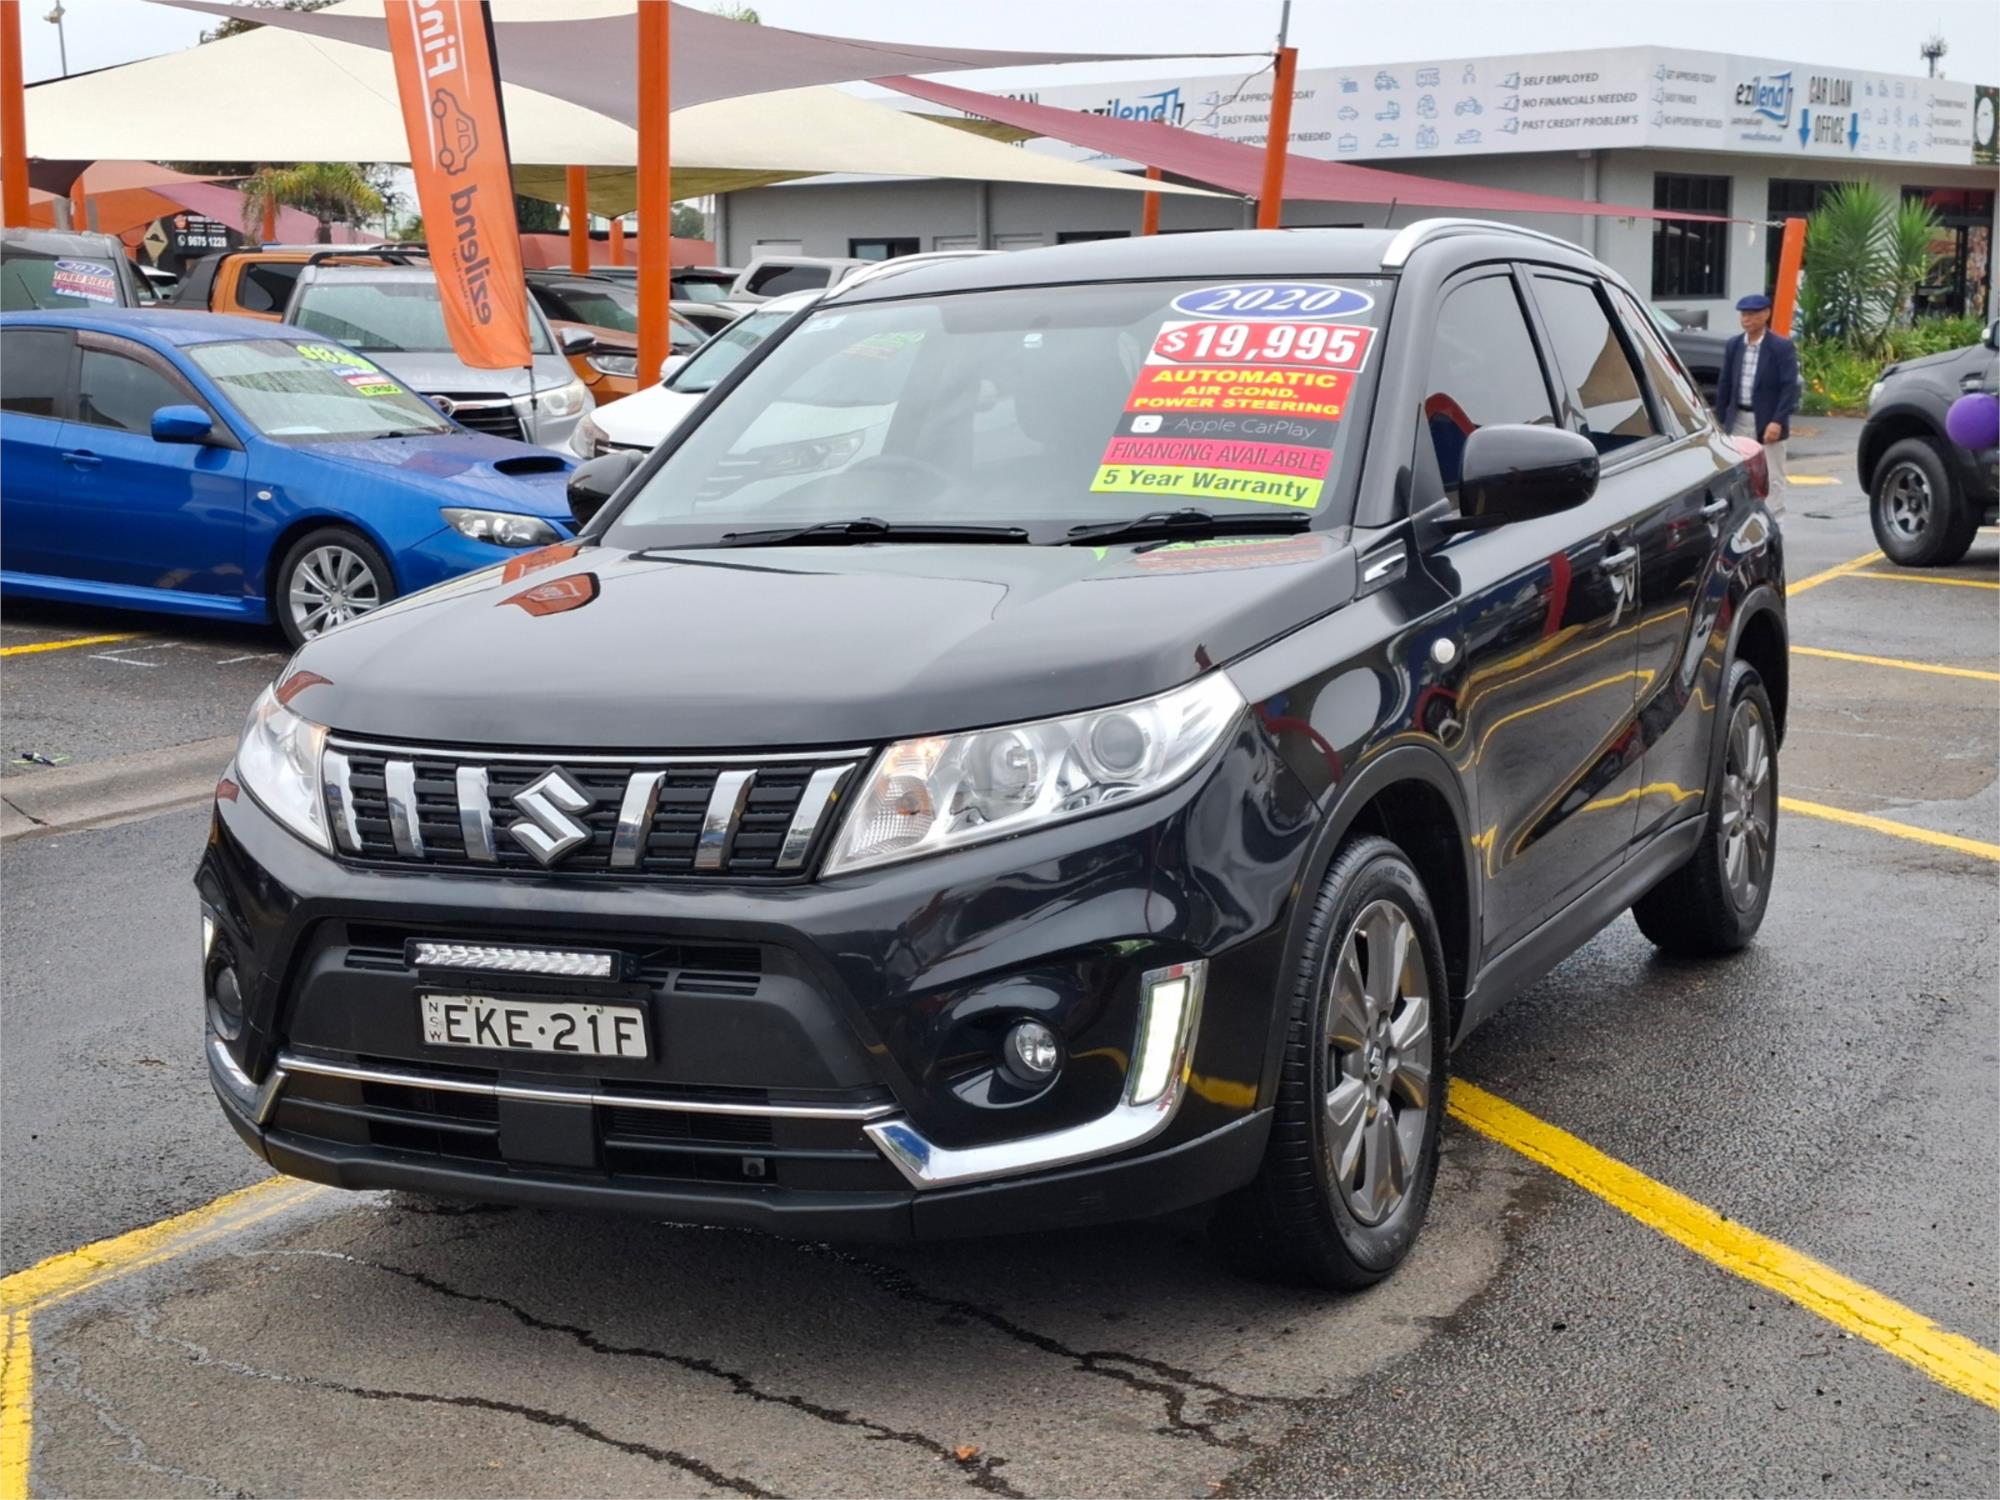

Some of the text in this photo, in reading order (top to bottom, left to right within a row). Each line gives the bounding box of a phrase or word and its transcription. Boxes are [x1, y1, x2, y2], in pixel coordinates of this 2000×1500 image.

[1522, 72, 1599, 87] SELF EMPLOYED
[1240, 92, 1273, 102] APPROV
[1292, 90, 1316, 101] ODAY
[1522, 92, 1639, 109] NO FINANCIALS NEEDED
[1735, 72, 1792, 112] ezilend
[1829, 77, 1852, 107] LOAN
[1222, 113, 1271, 125] EASY FINAN
[1521, 114, 1639, 130] PAST CREDIT PROBLEM'S
[1297, 131, 1331, 142] NEEDED
[1814, 114, 1844, 144] OFFICE
[1196, 288, 1341, 312] 2020
[1162, 324, 1361, 363] $19,995
[1152, 369, 1339, 388] AUTOMATIC
[1182, 385, 1299, 399] AIR COND.
[1133, 397, 1341, 415] POWER STEERING
[1174, 417, 1318, 441] Apple CarPlay
[1110, 440, 1325, 472] FINANCING AVAILABLE
[1103, 469, 1310, 502] 5 Year Warranty
